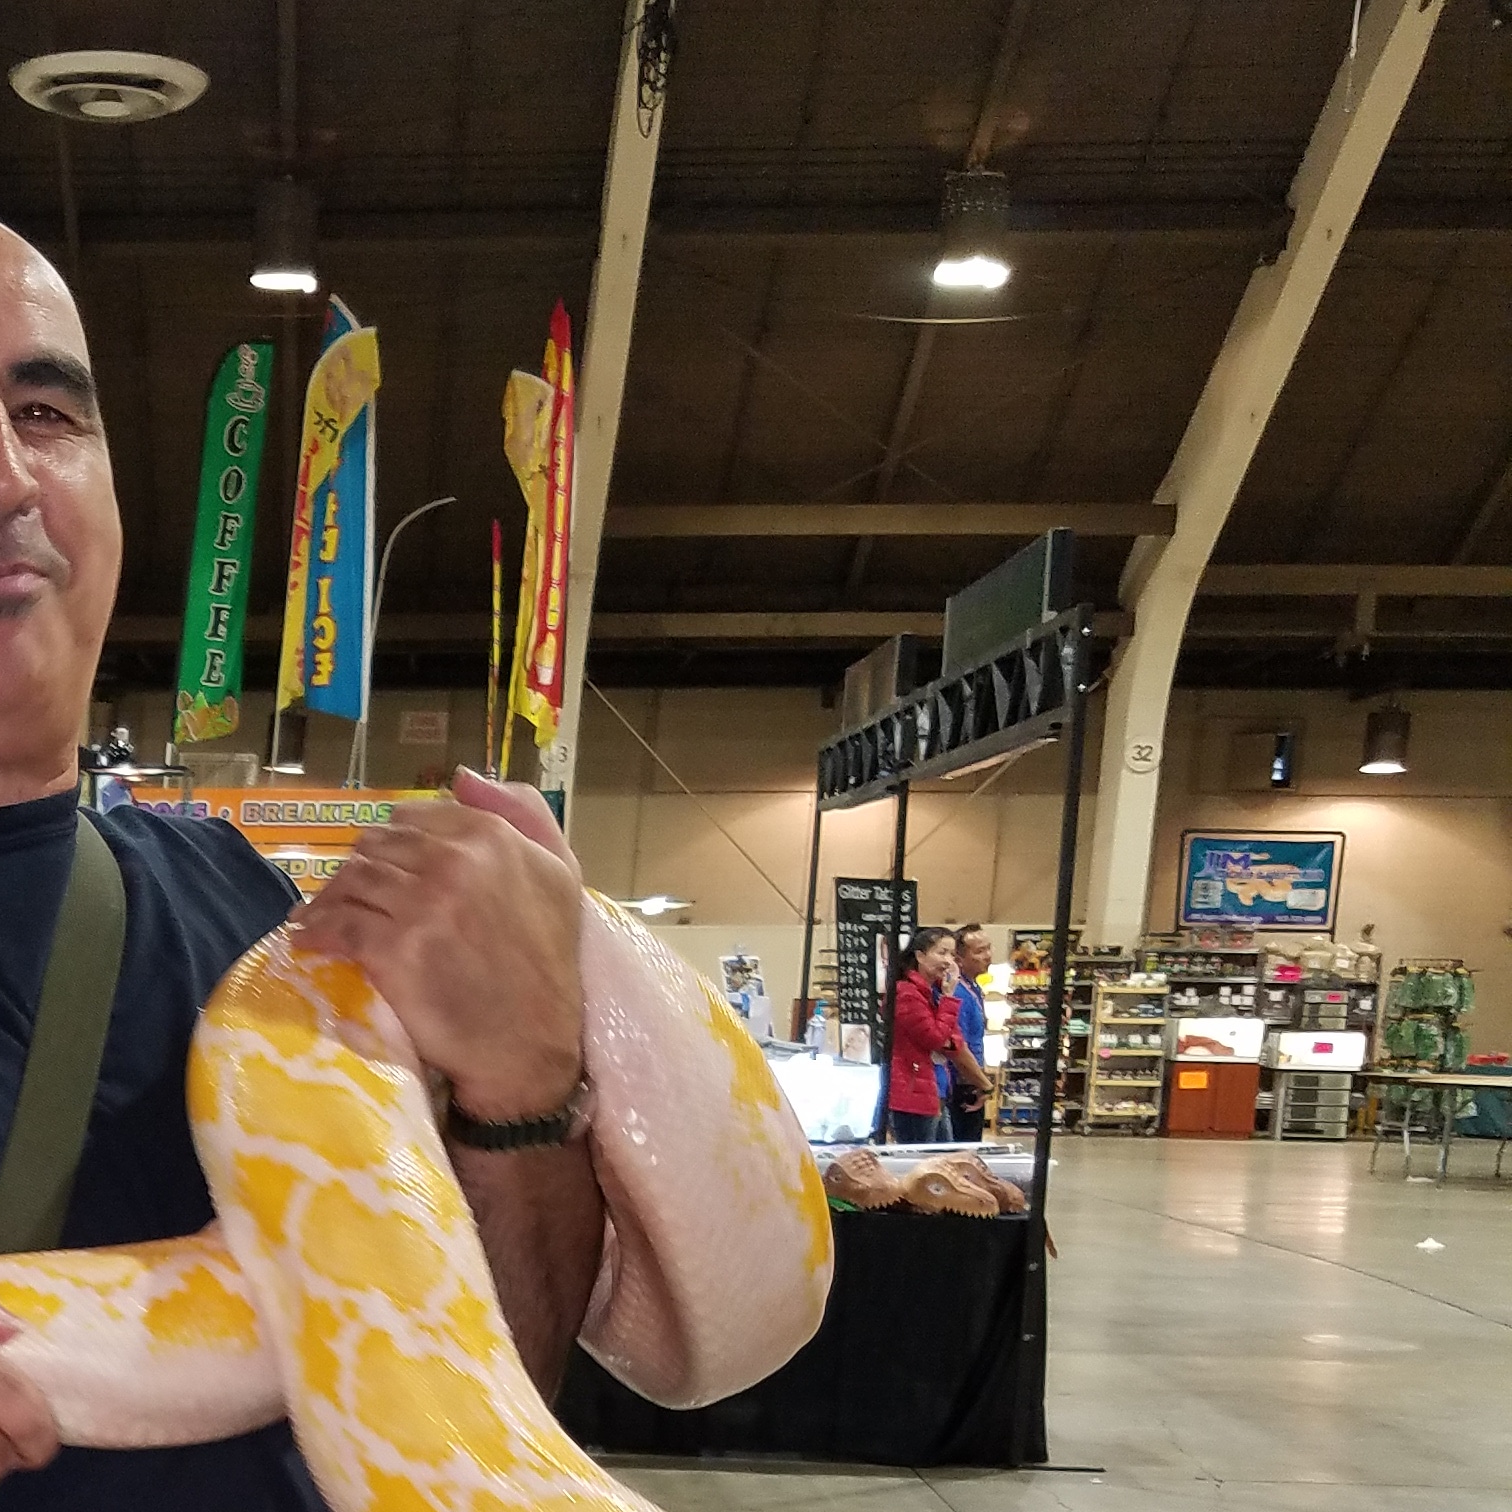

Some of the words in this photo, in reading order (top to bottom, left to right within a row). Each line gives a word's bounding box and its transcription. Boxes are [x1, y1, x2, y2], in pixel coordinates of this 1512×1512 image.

[201, 415, 250, 687] COFFEE
[1131, 744, 1153, 762] 32
[243, 802, 392, 822] BREAKFAS
